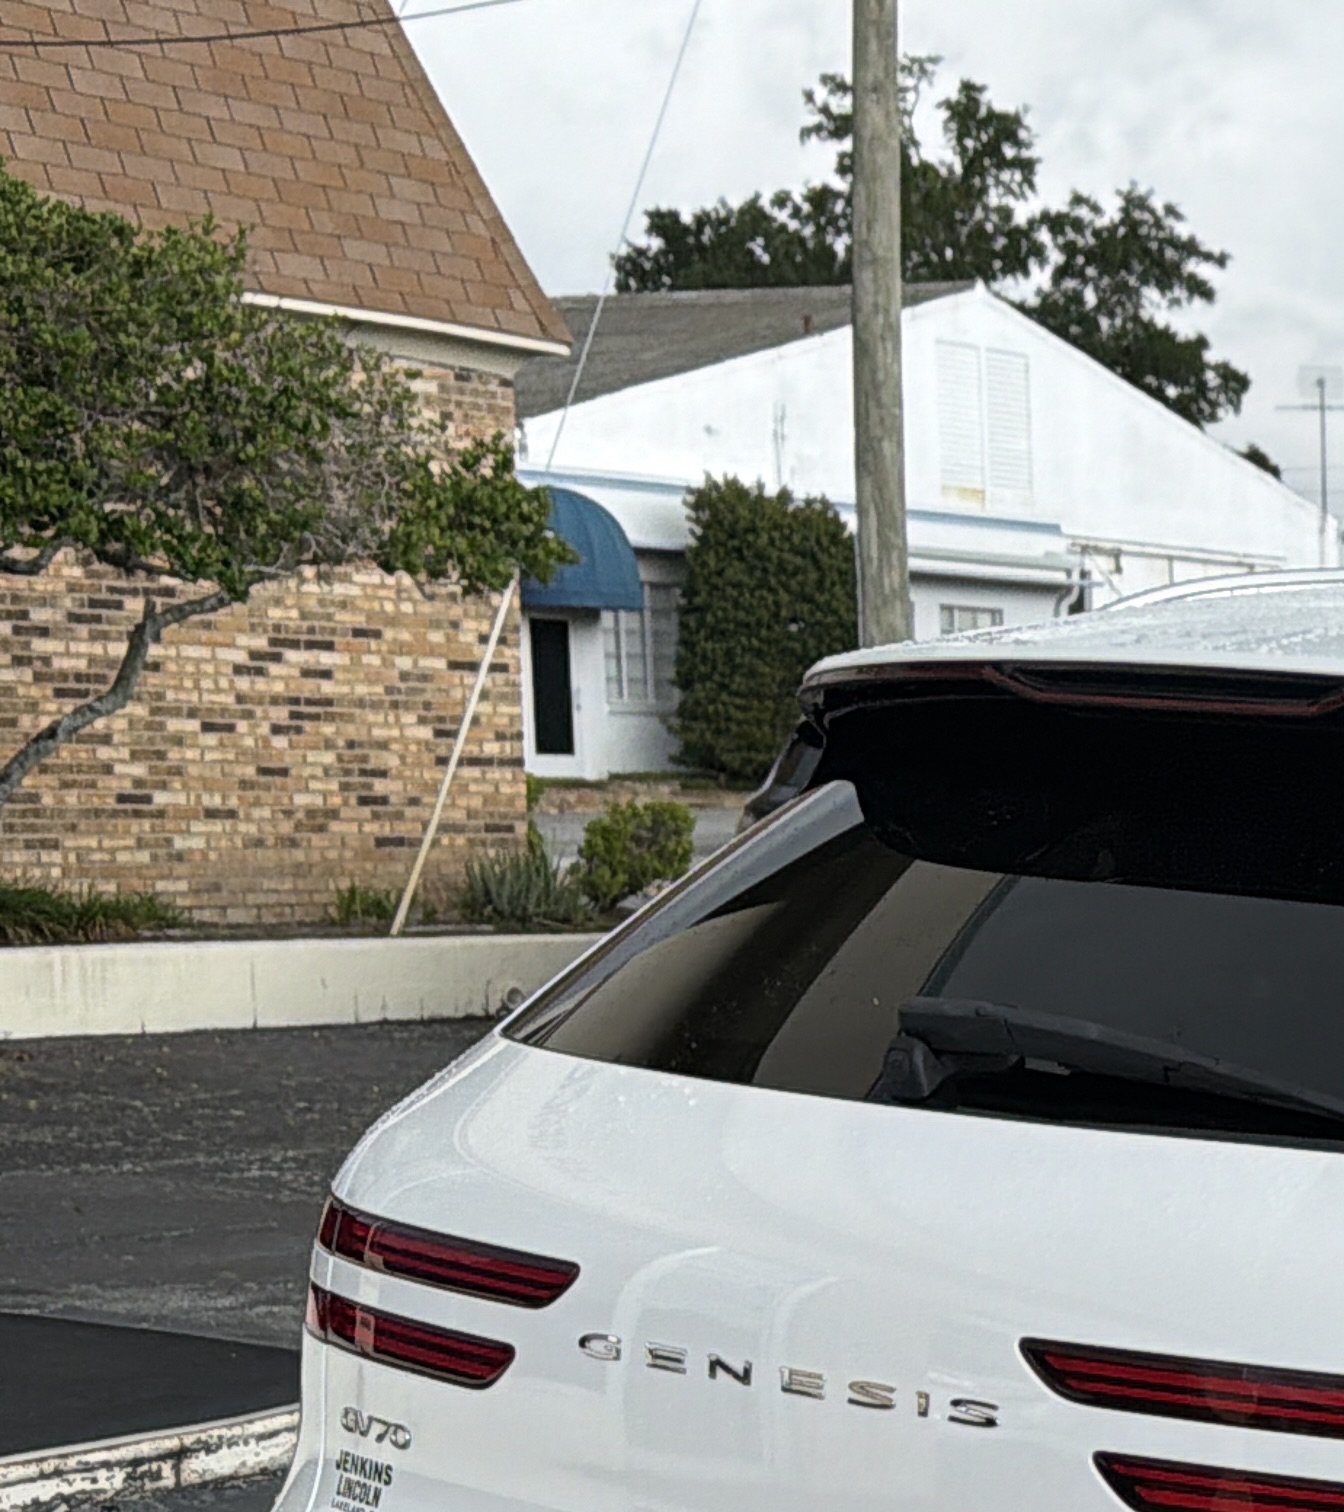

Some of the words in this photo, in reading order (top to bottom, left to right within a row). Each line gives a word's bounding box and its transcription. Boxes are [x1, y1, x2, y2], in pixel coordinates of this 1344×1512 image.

[578, 1333, 1000, 1428] GENESIS
[340, 1406, 412, 1450] GV70
[335, 1449, 393, 1486] JENKINS
[336, 1473, 382, 1508] LINCOLN
